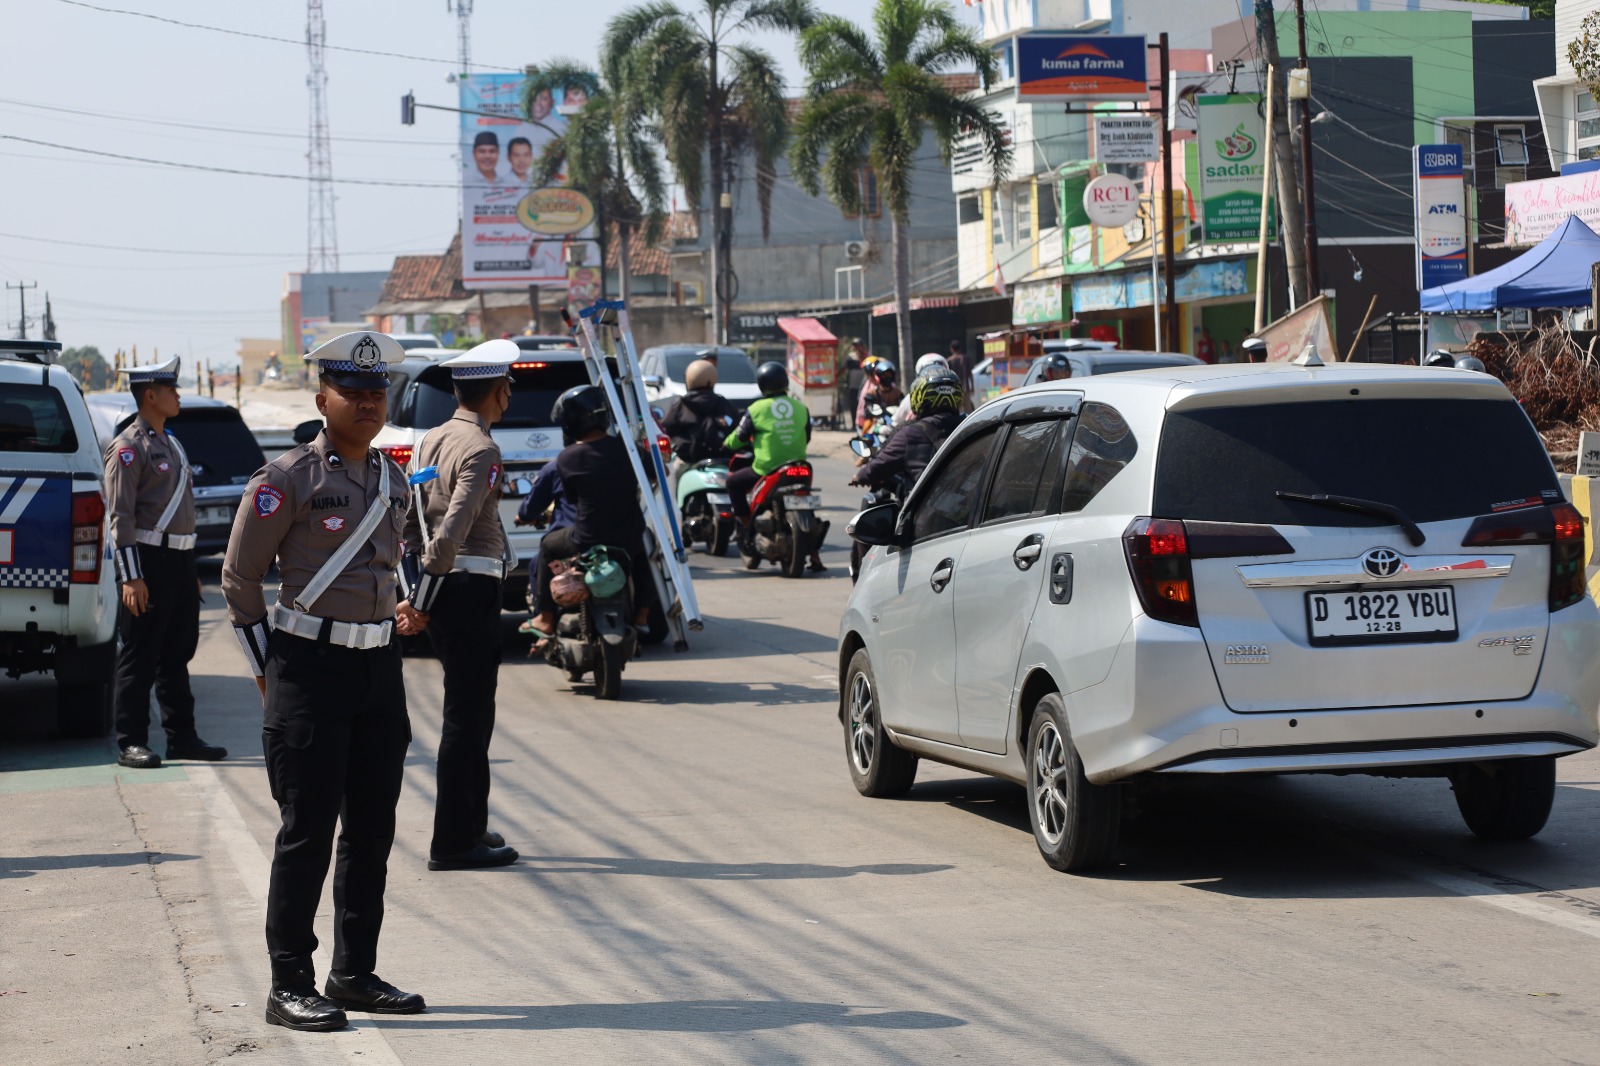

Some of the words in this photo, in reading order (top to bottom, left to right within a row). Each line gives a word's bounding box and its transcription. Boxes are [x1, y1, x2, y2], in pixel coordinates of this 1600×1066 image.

[1083, 58, 1124, 69] farma
[1437, 153, 1457, 167] BRI
[1428, 204, 1457, 215] ATM
[740, 315, 776, 327] TERAS
[1314, 596, 1329, 622] D
[1344, 593, 1400, 621] 1822
[1407, 591, 1449, 618] YBU
[1226, 644, 1269, 655] ASTRA
